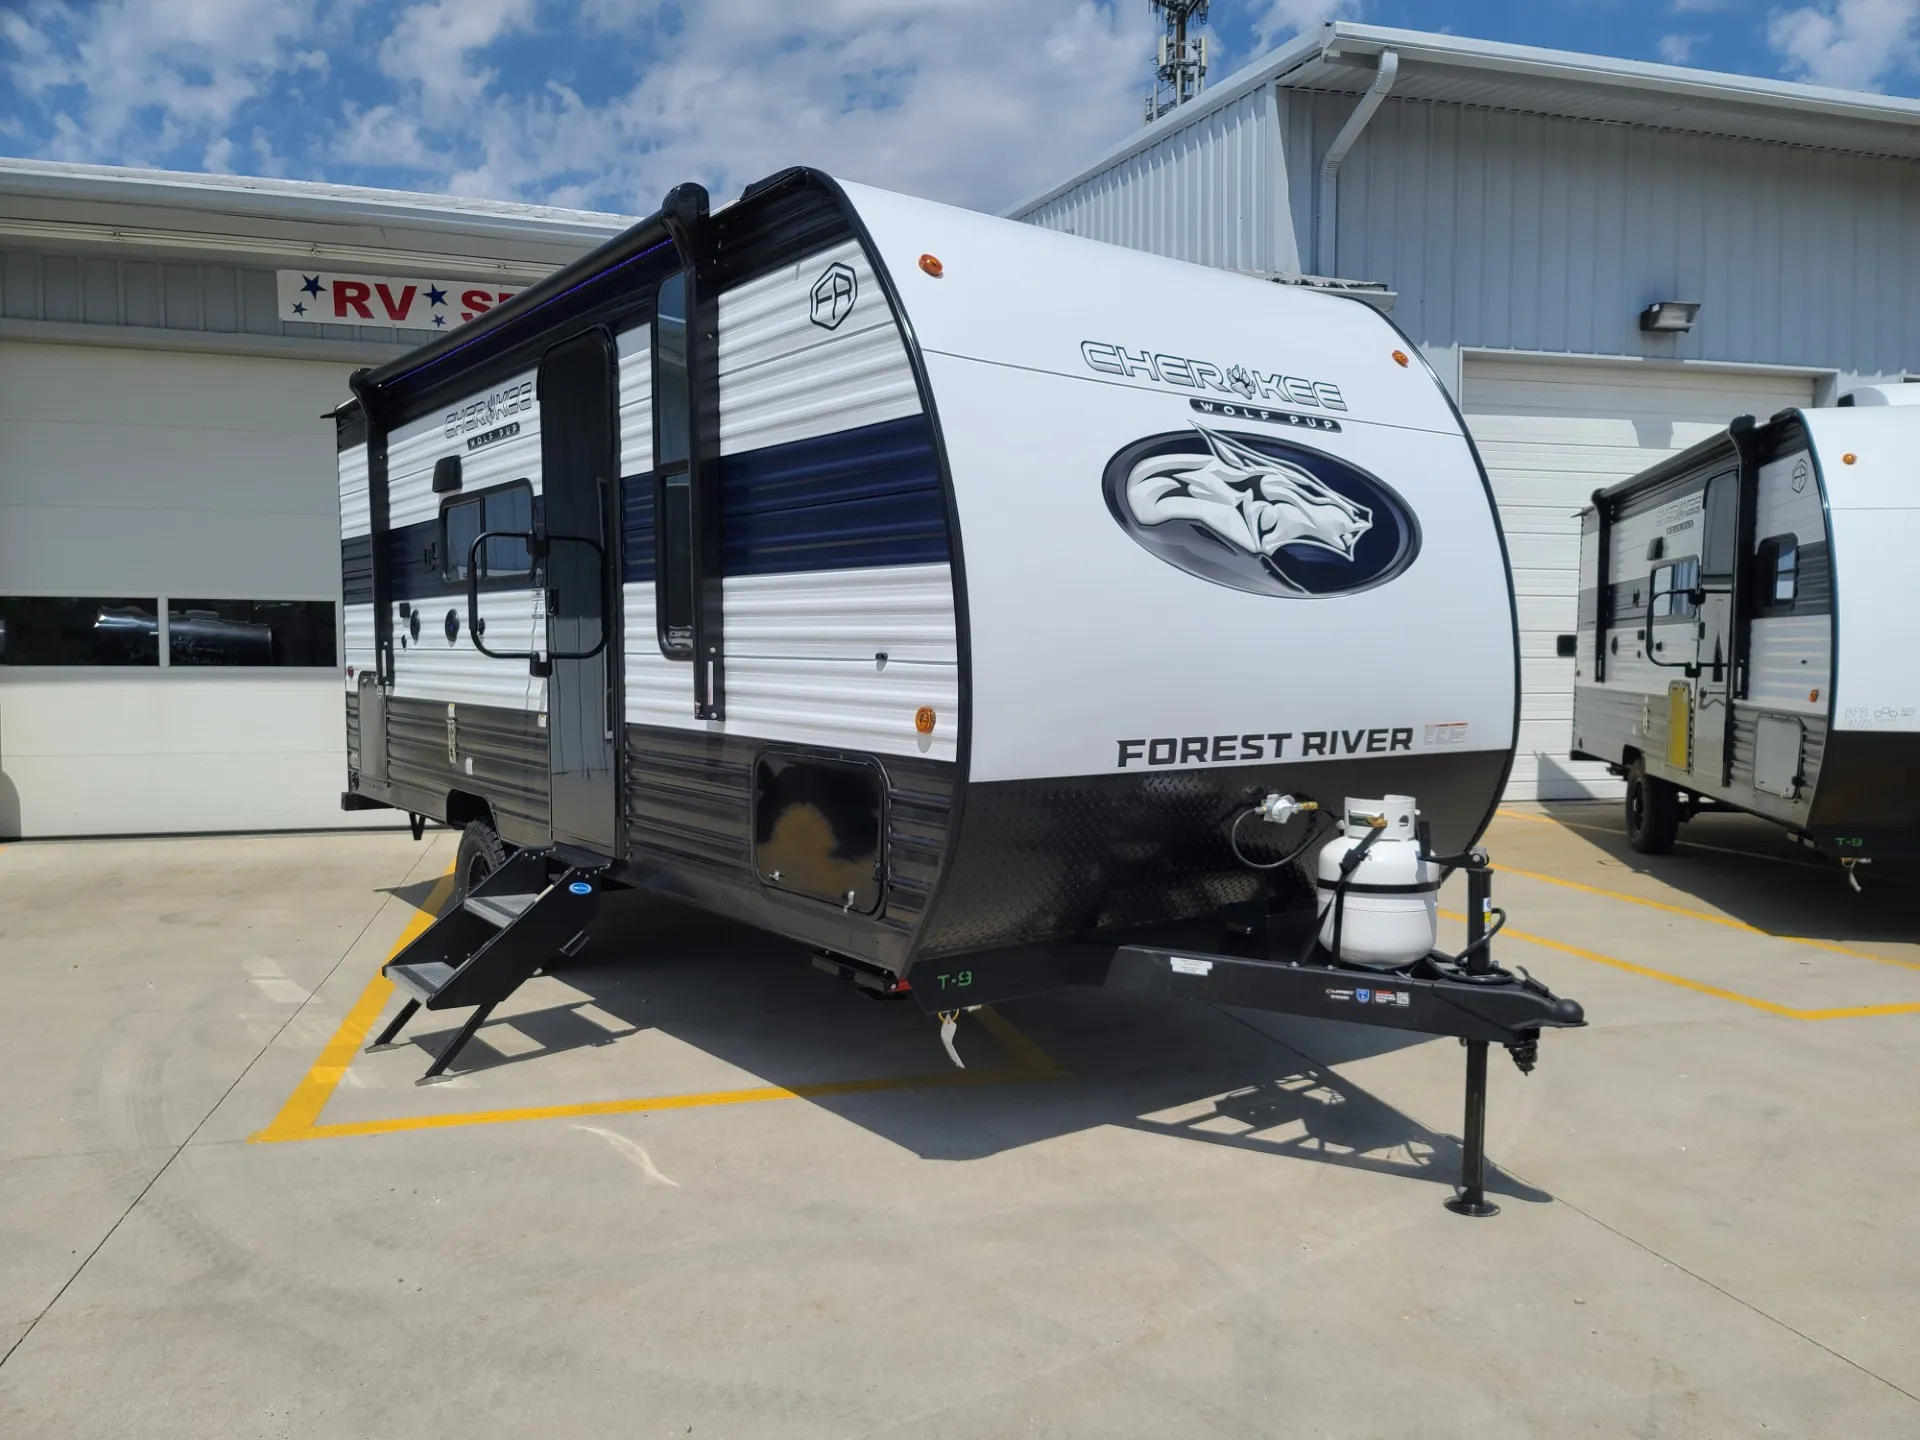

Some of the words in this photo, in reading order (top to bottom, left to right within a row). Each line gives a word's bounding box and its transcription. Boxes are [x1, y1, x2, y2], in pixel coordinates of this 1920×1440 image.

[332, 280, 418, 321] RV
[460, 290, 516, 322] S
[1199, 401, 1270, 421] WOLF
[1289, 415, 1334, 431] PUP
[468, 432, 493, 447] WOLF
[499, 424, 518, 437] PUP
[1116, 732, 1292, 767] FOREST
[1301, 727, 1414, 757] RIVER
